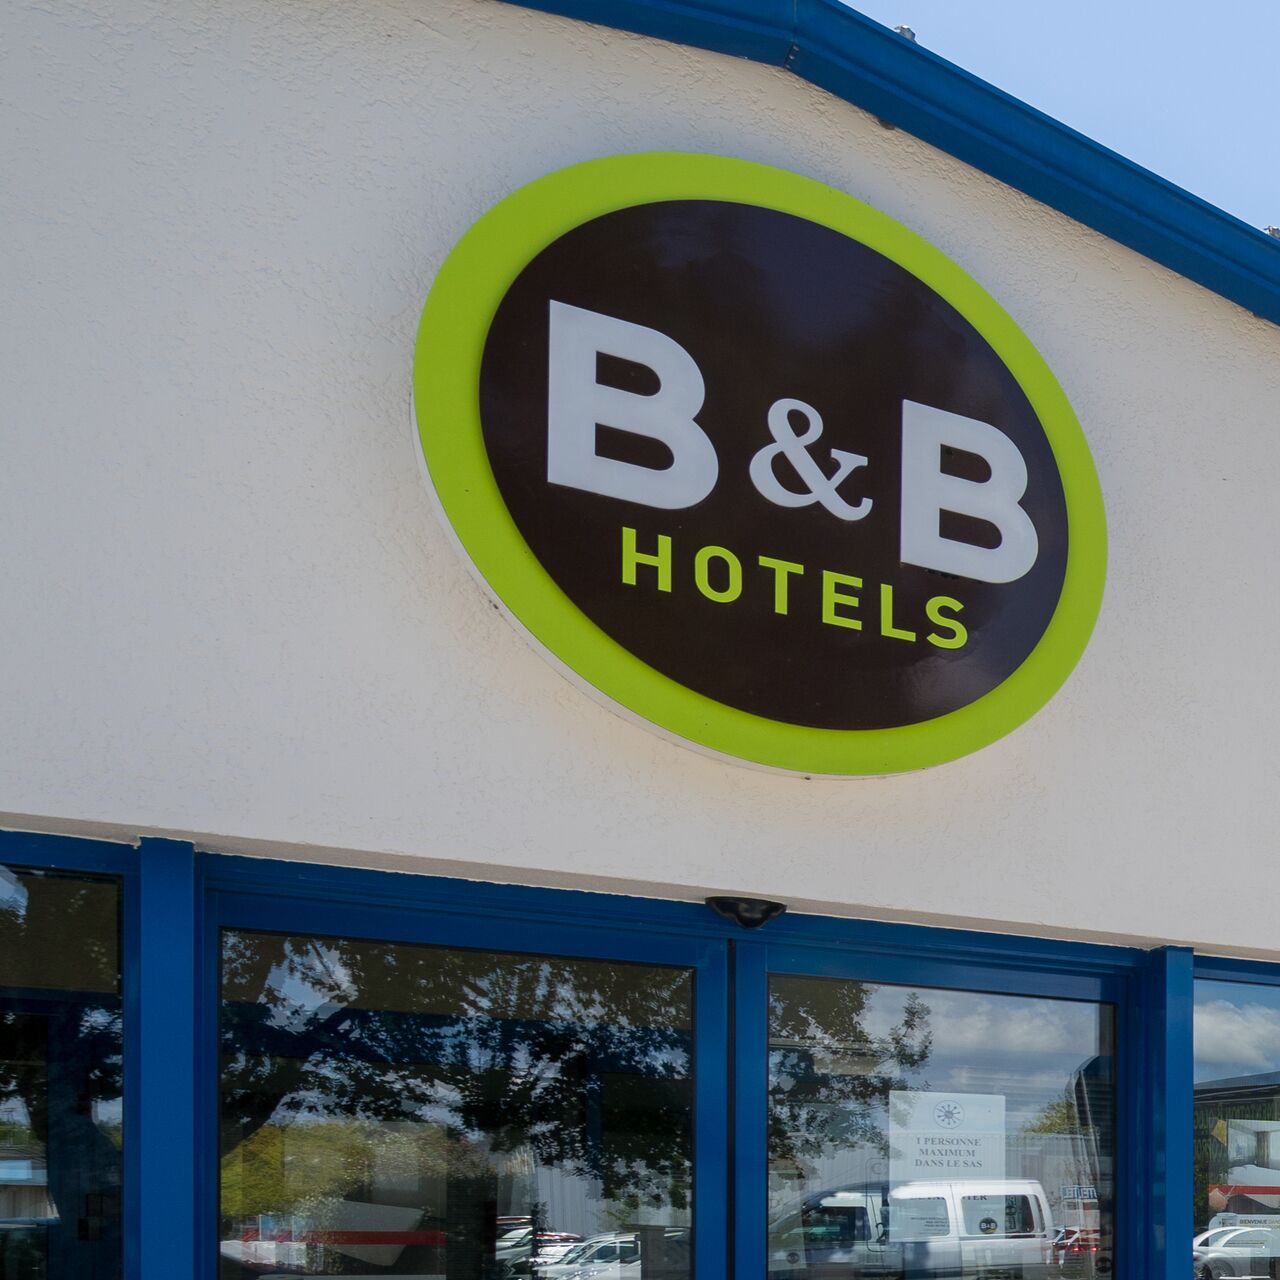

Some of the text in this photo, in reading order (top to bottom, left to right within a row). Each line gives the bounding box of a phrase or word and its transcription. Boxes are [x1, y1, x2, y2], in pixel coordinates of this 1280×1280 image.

[546, 299, 1040, 584] B&B
[621, 526, 969, 651] HOTELS
[924, 1137, 982, 1147] PERSONNE
[919, 1148, 976, 1157] MAXIMUM
[915, 1159, 983, 1169] DANS LE SAS
